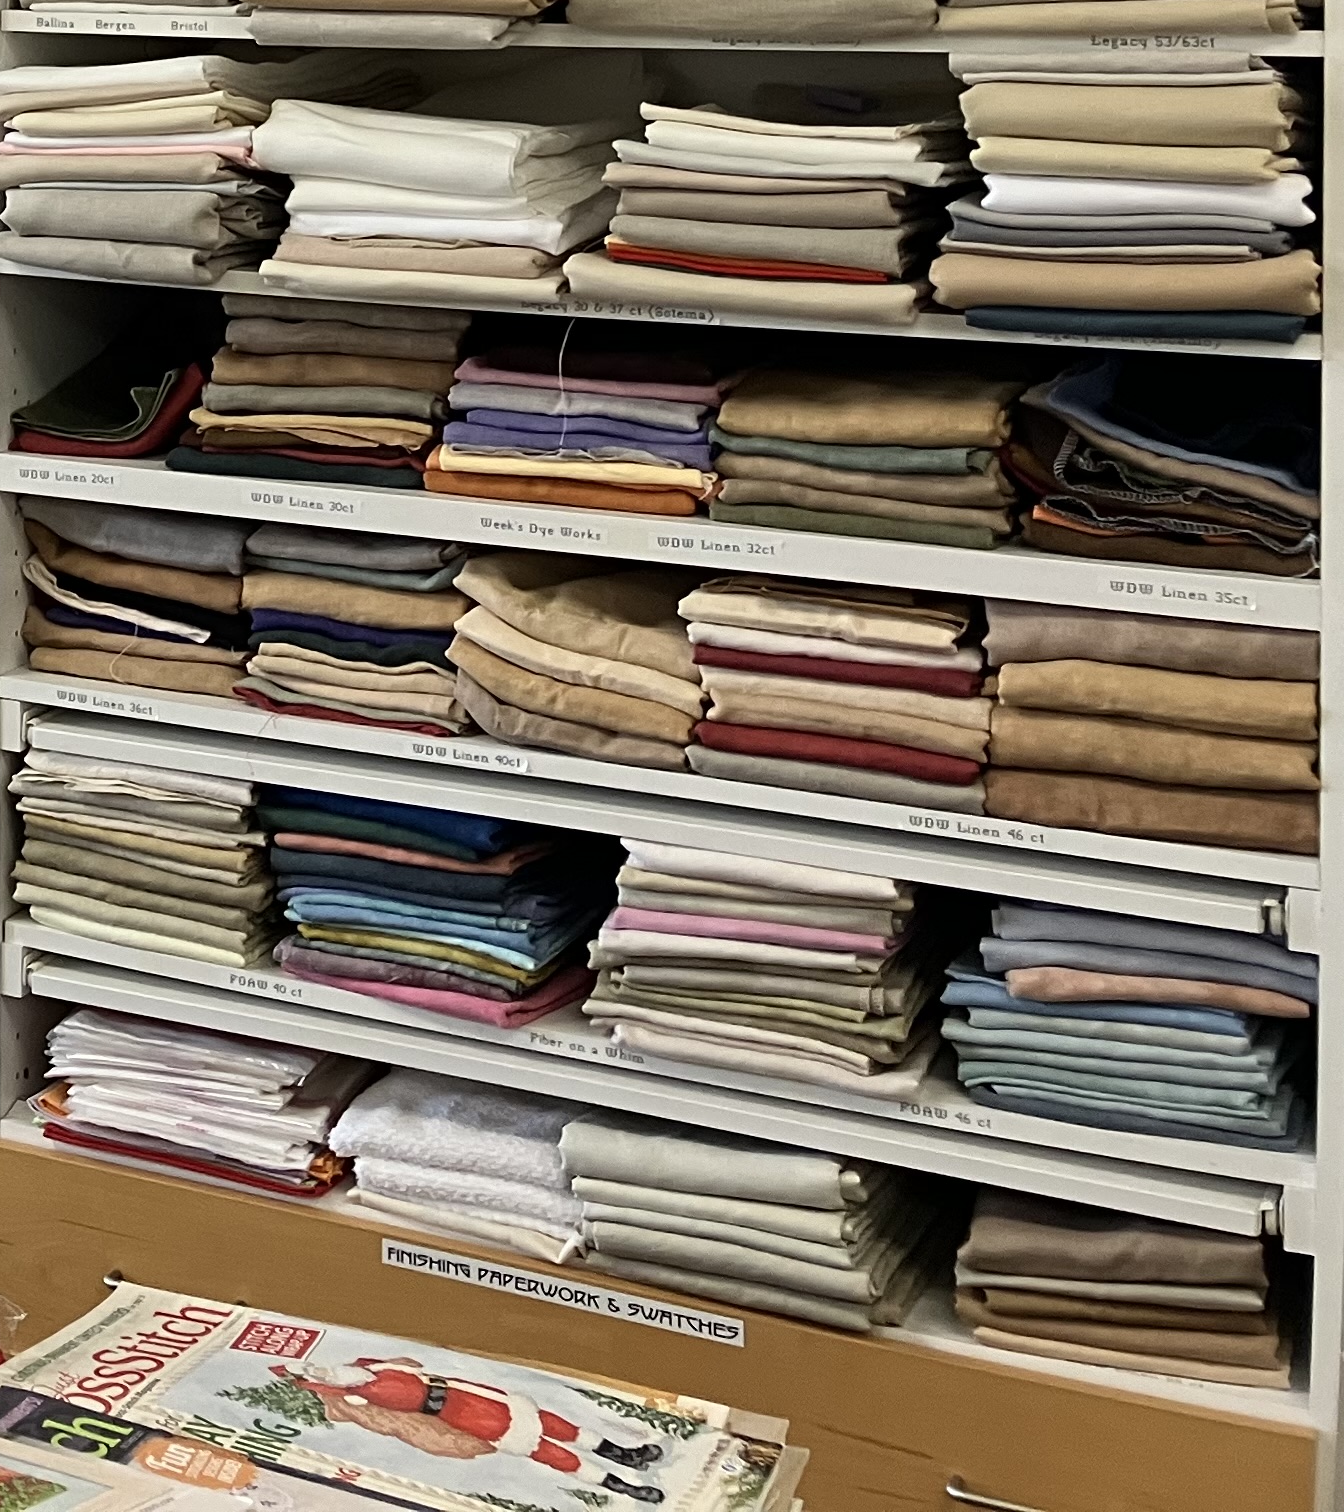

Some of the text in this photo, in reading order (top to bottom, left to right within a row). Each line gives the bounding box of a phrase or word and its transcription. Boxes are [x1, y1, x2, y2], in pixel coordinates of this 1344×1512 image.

[36, 17, 75, 30] Ballina
[94, 19, 135, 32] Bergen
[170, 20, 208, 32] Bristol
[1089, 35, 1215, 50] Legacy 53/63ct
[573, 301, 589, 312] 30
[609, 303, 624, 314] 37
[18, 468, 115, 486] WDW Linen 20ct
[250, 491, 355, 515] WDW Linen 30ct
[479, 517, 602, 541] Week's Dye Works
[657, 535, 776, 556] WDW Linen 32ct
[1109, 580, 1249, 607] WDW Linen 35ct
[56, 689, 153, 716] WDW Linen 36ct
[411, 742, 521, 769] WDW Linen 40ct
[908, 815, 950, 831] WDW
[956, 821, 1000, 839] Linen
[1007, 828, 1024, 842] 46
[228, 973, 268, 991] FOAW
[272, 982, 287, 996] 40
[528, 1031, 646, 1066] Fiber on a Whim
[898, 1100, 949, 1120] FOAW
[953, 1112, 972, 1126] 46
[386, 1246, 741, 1340] FINISHING PAPERWORK & SWATCHES
